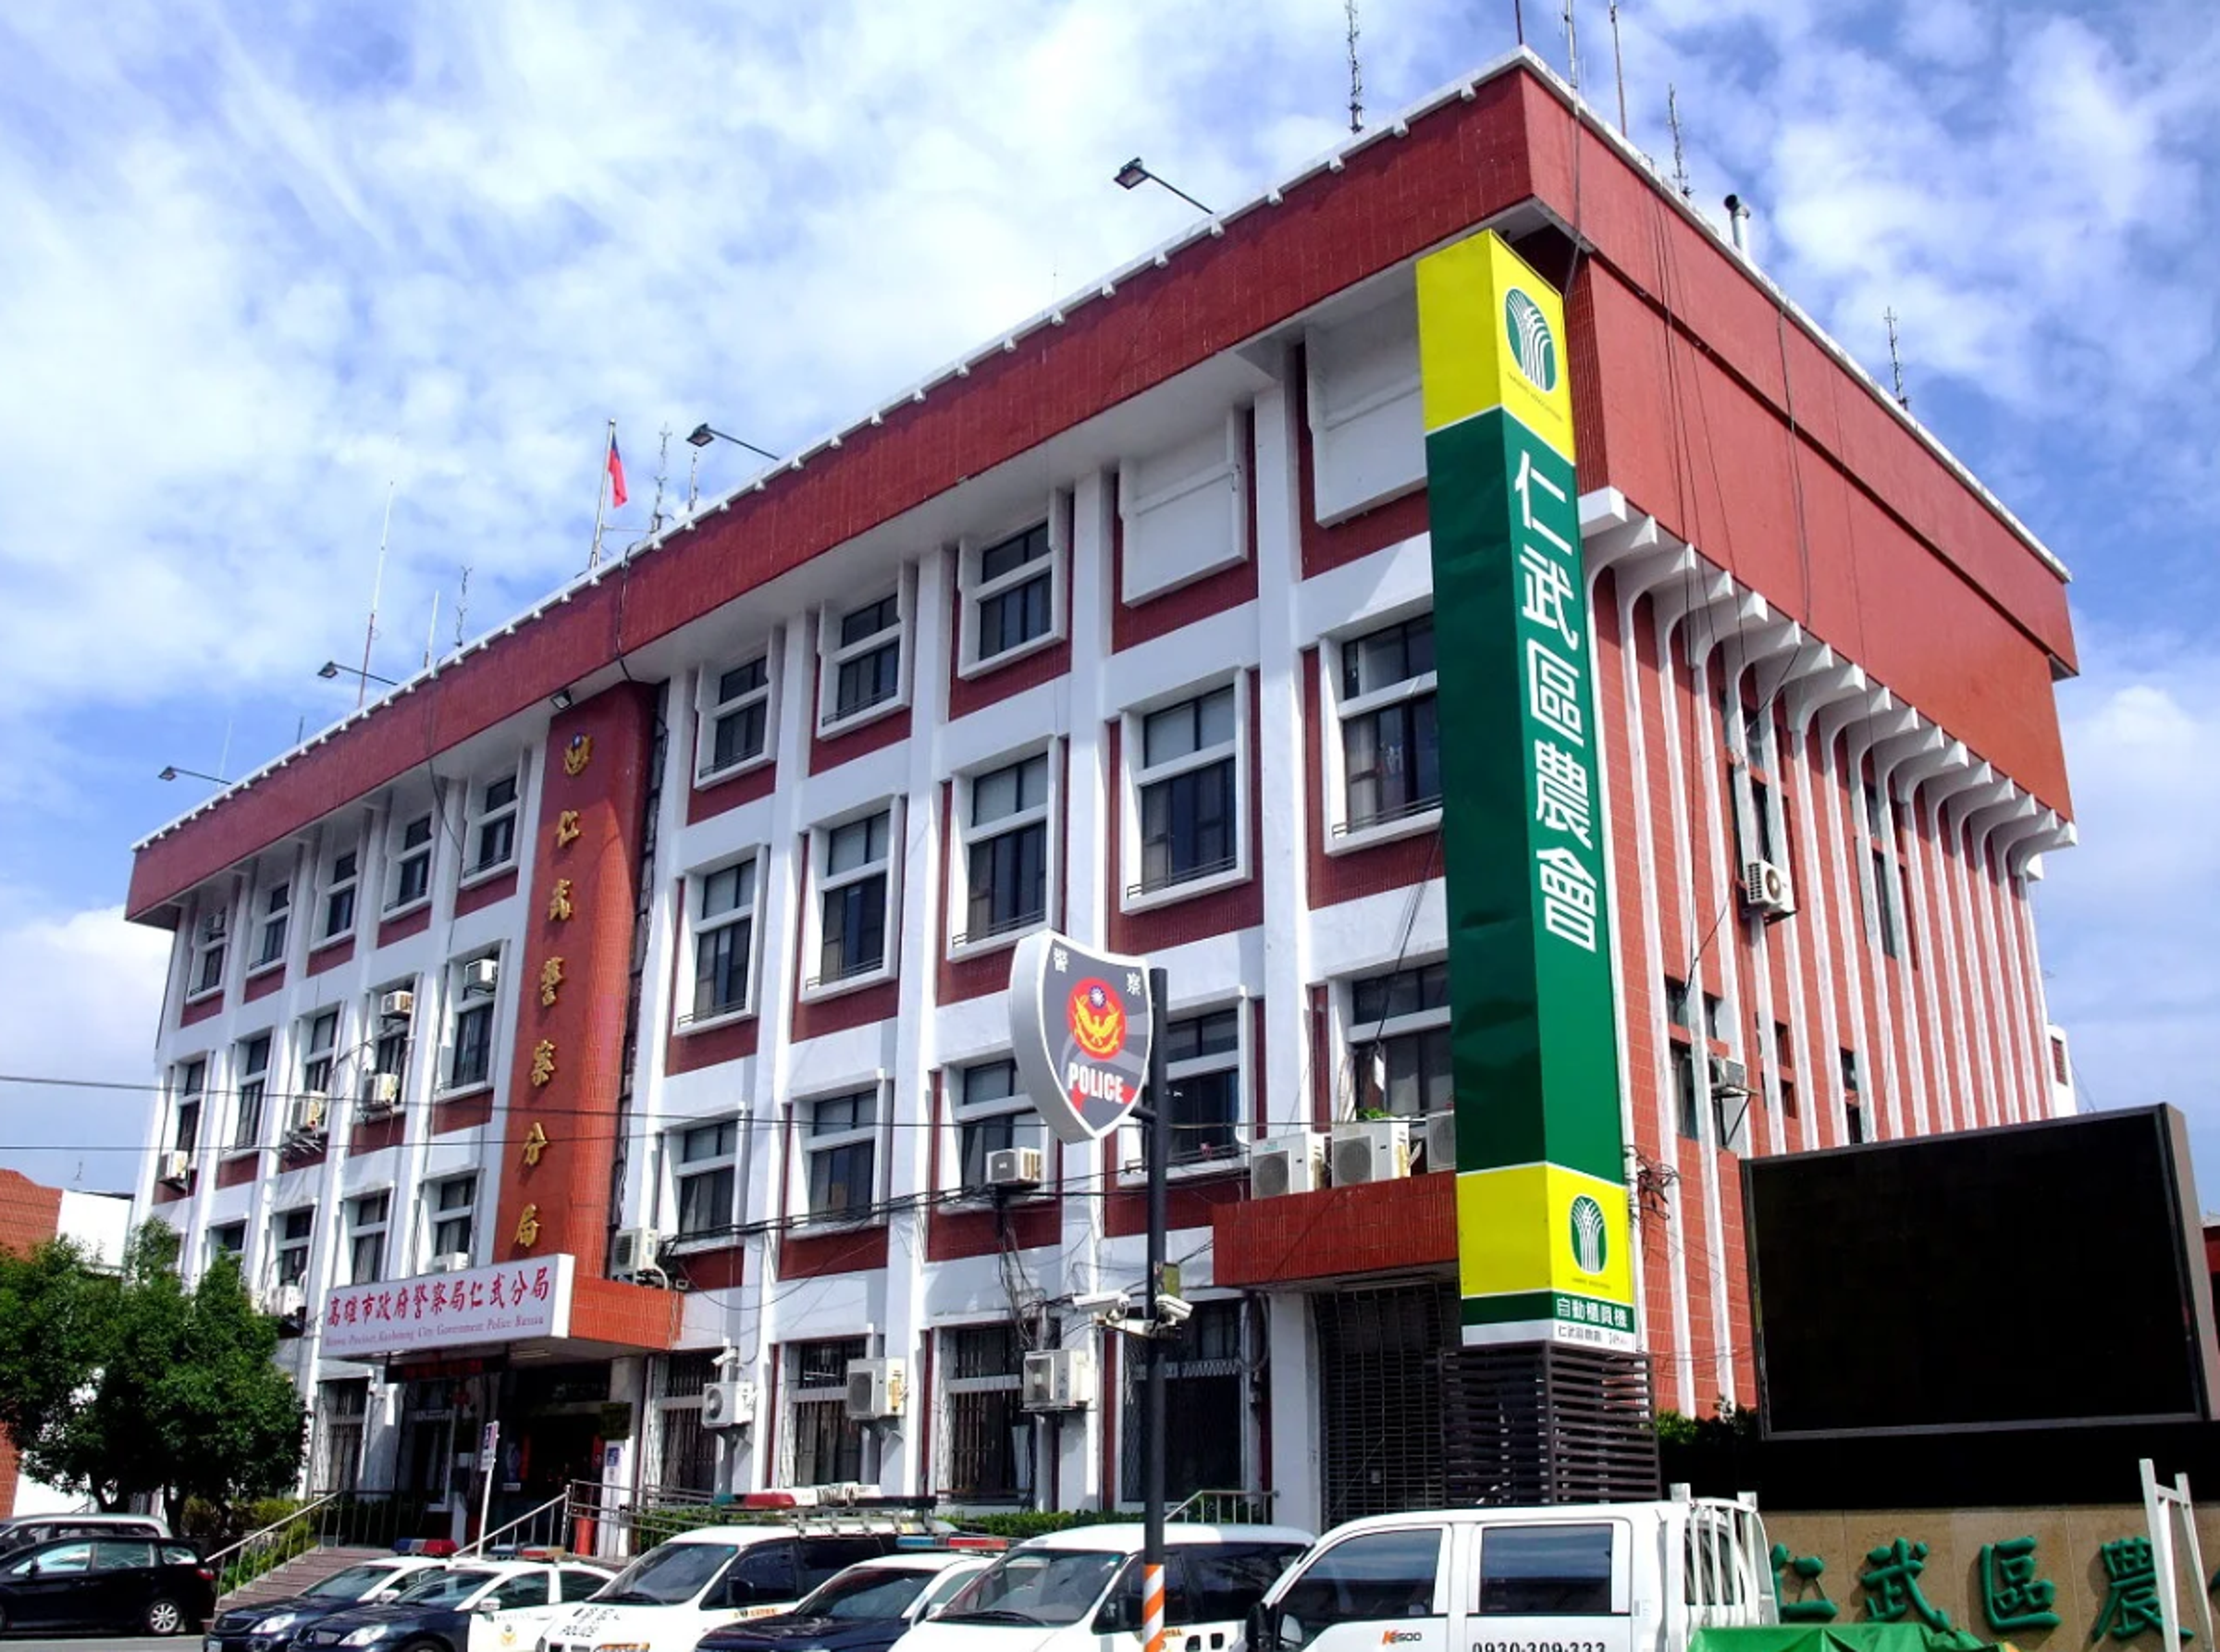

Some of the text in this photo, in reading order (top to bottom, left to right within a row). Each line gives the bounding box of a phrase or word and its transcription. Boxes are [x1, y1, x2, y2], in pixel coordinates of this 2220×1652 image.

[1514, 450, 1597, 953] 仁武區農會
[514, 810, 580, 1245] 仁武警察分局
[1068, 1062, 1124, 1104] POLICE
[327, 1265, 549, 1327] 高雄市政府警察局仁武分局
[1556, 1297, 1628, 1329] 自動櫃員機
[1771, 1535, 2220, 1644] 仁武區農
